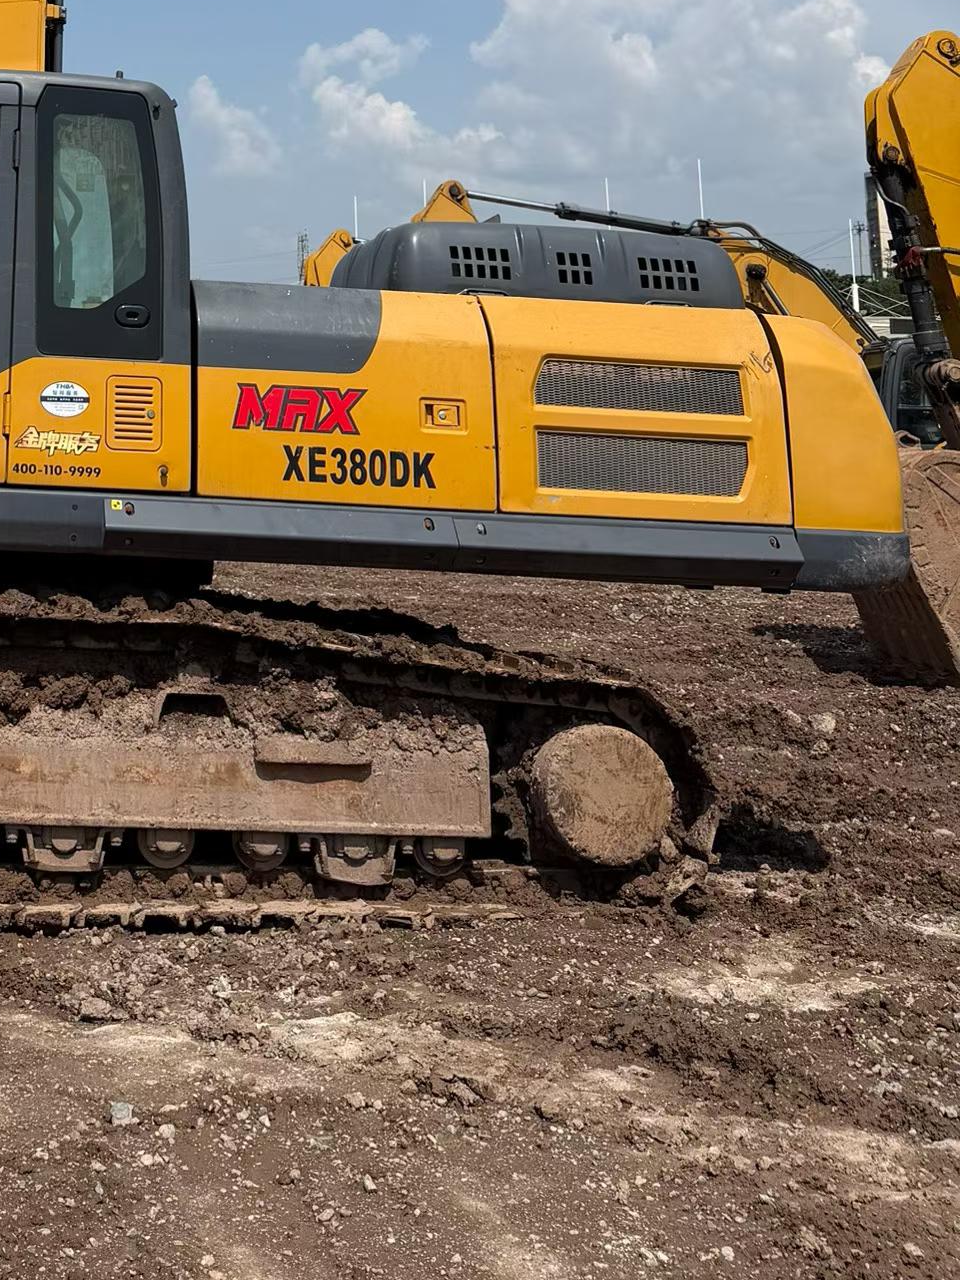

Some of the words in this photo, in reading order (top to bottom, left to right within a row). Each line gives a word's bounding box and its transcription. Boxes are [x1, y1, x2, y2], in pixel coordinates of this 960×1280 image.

[232, 383, 368, 435] MAX
[14, 426, 101, 457] 金牌服务
[12, 463, 101, 477] 400-110-9999
[282, 445, 437, 489] XE380DK
